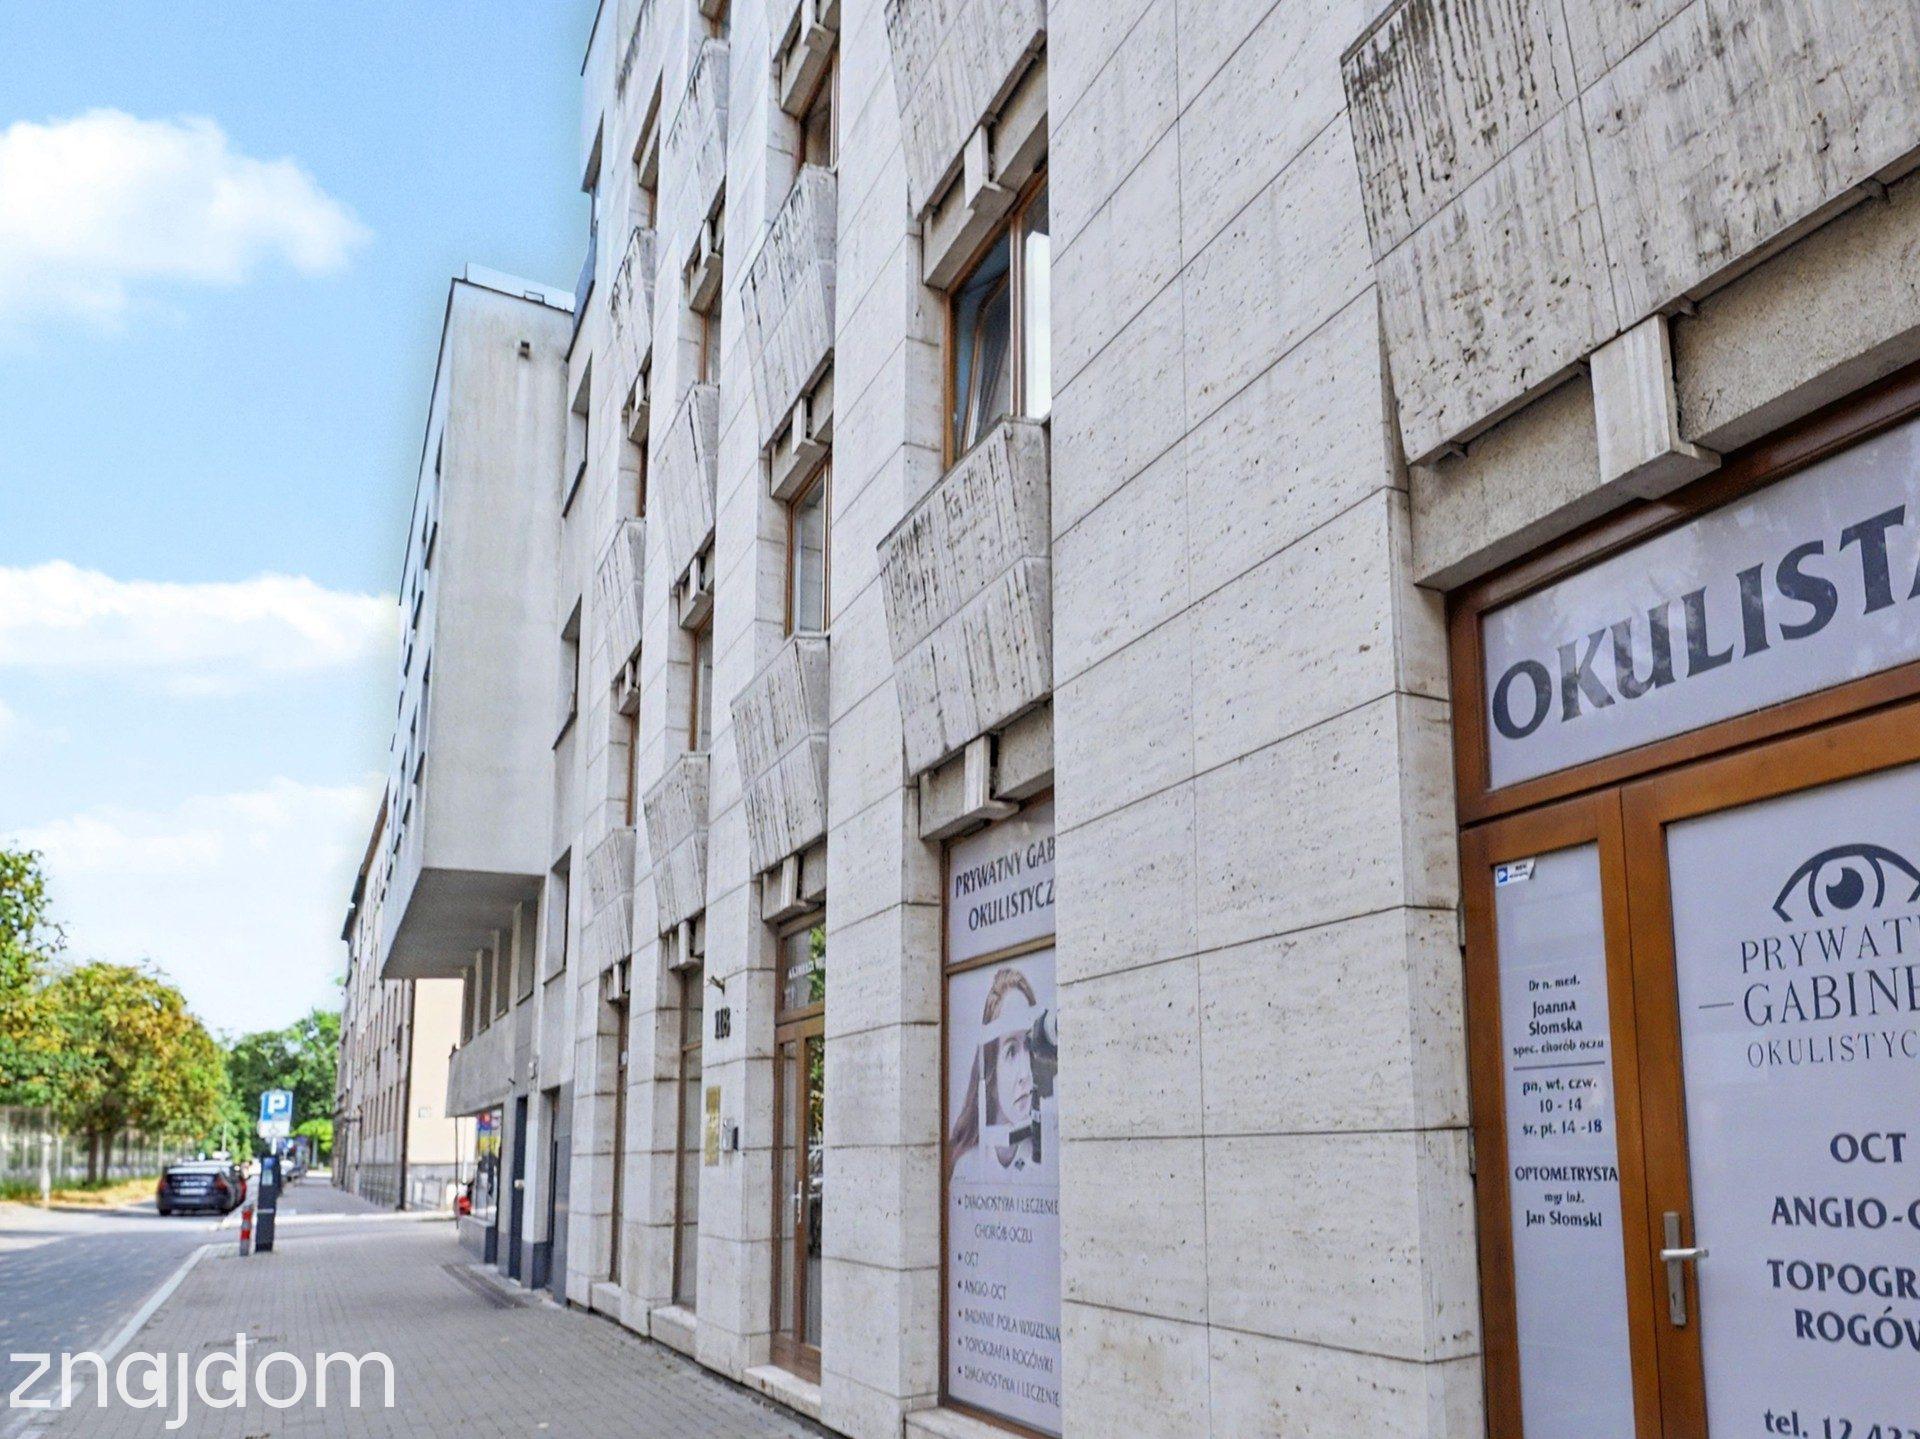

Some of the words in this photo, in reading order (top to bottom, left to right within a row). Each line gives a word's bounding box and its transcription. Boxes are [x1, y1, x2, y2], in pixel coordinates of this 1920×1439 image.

[1492, 504, 1920, 740] OKULIST
[955, 848, 1022, 898] PRYWATNY
[1741, 914, 1920, 974] PRYWAT
[1529, 980, 1540, 991] Dr
[1542, 980, 1553, 990] n.
[1555, 974, 1580, 988] med.
[1533, 1000, 1577, 1019] Joanna
[1513, 1044, 1539, 1058] spec.
[1579, 1039, 1604, 1051] oczu
[1568, 1078, 1597, 1090] czw.
[1540, 1098, 1553, 1113] 10
[1569, 1097, 1582, 1112] 14
[1562, 1120, 1576, 1134] 14
[1829, 1132, 1907, 1163] OCT
[1514, 1165, 1619, 1182] OPTOMETRYSTA
[1544, 1193, 1563, 1206] mgr
[1526, 1209, 1546, 1227] Jan
[1008, 1226, 1033, 1244] OCZU
[964, 1250, 979, 1267] OCT
[1764, 1408, 1808, 1438] tel.
